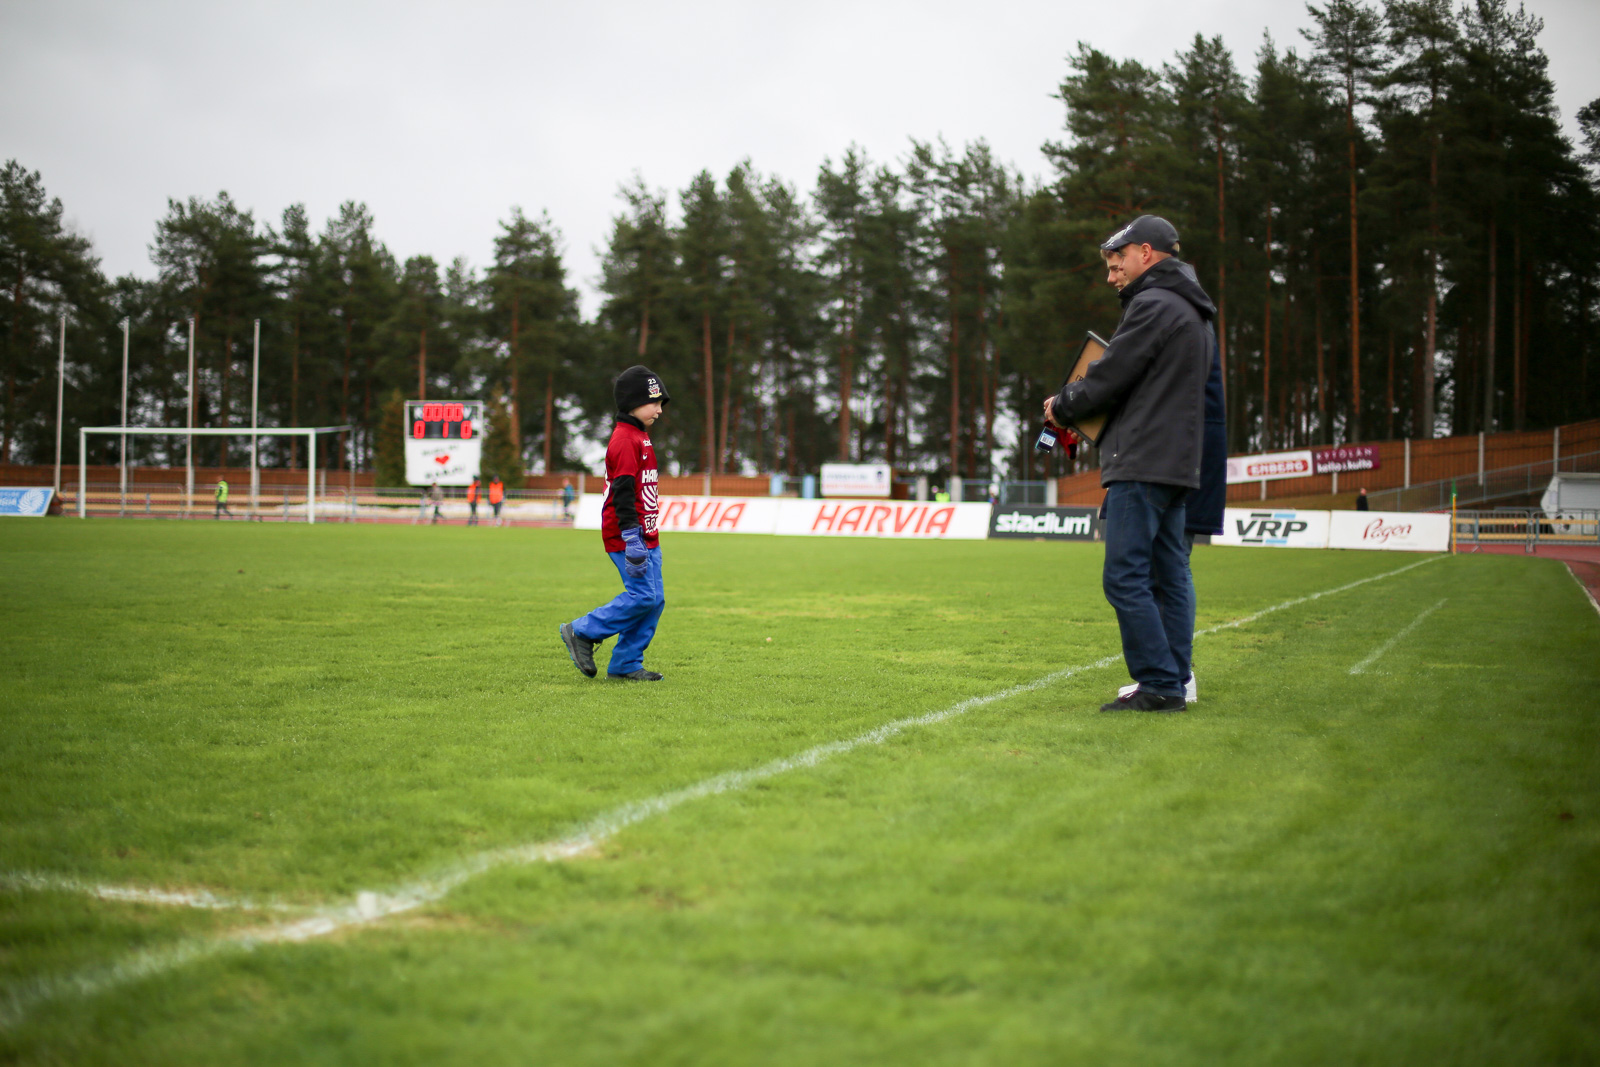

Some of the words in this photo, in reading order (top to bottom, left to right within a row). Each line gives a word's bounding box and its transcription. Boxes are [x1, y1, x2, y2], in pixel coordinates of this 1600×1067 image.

[659, 502, 747, 528] RVIA
[812, 504, 955, 534] HARVIA
[995, 511, 1091, 535] stadium
[1236, 520, 1308, 537] VRP
